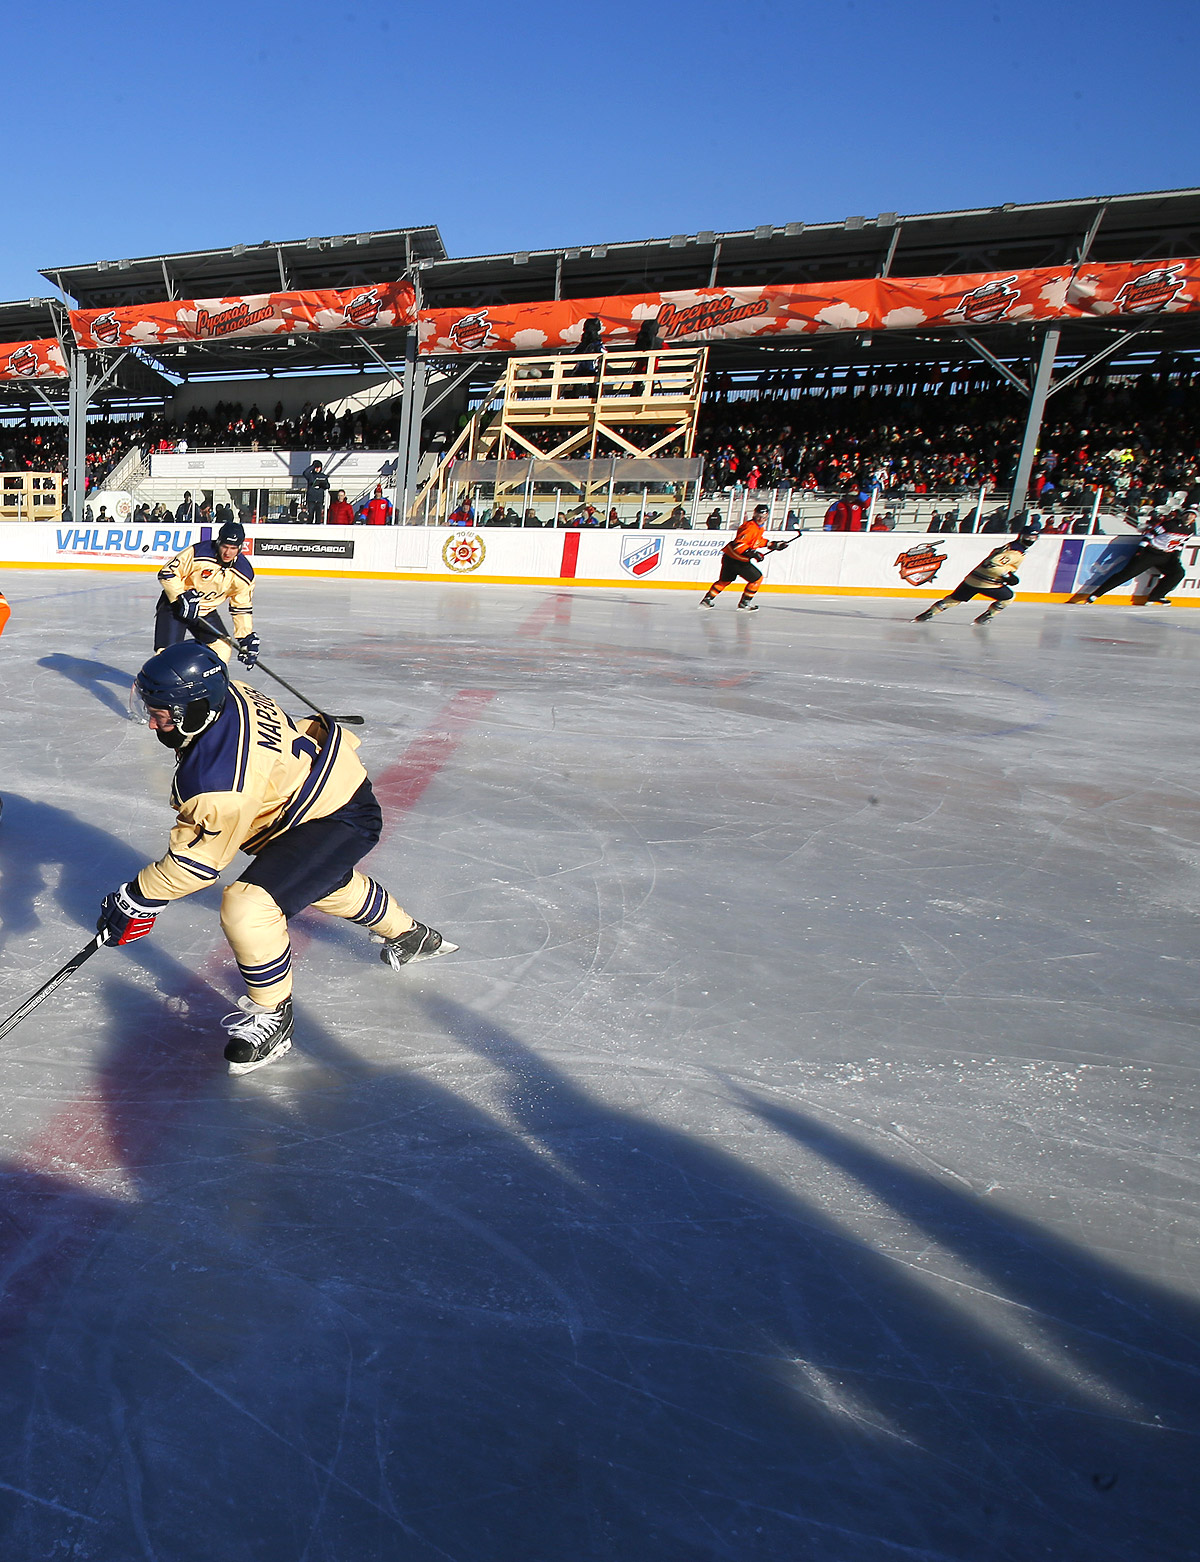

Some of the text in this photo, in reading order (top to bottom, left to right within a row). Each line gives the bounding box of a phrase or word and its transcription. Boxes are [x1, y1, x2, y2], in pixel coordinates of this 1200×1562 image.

[197, 303, 250, 336] Русская
[215, 305, 274, 337] классика
[657, 295, 734, 336] Русская
[677, 300, 768, 337] классика
[56, 529, 192, 552] VHLRU.RU
[674, 539, 725, 547] Высшая
[627, 543, 657, 565] ВХЛ
[672, 557, 701, 566] Лига
[202, 664, 222, 679] CCM
[31, 979, 59, 1008] COVERT
